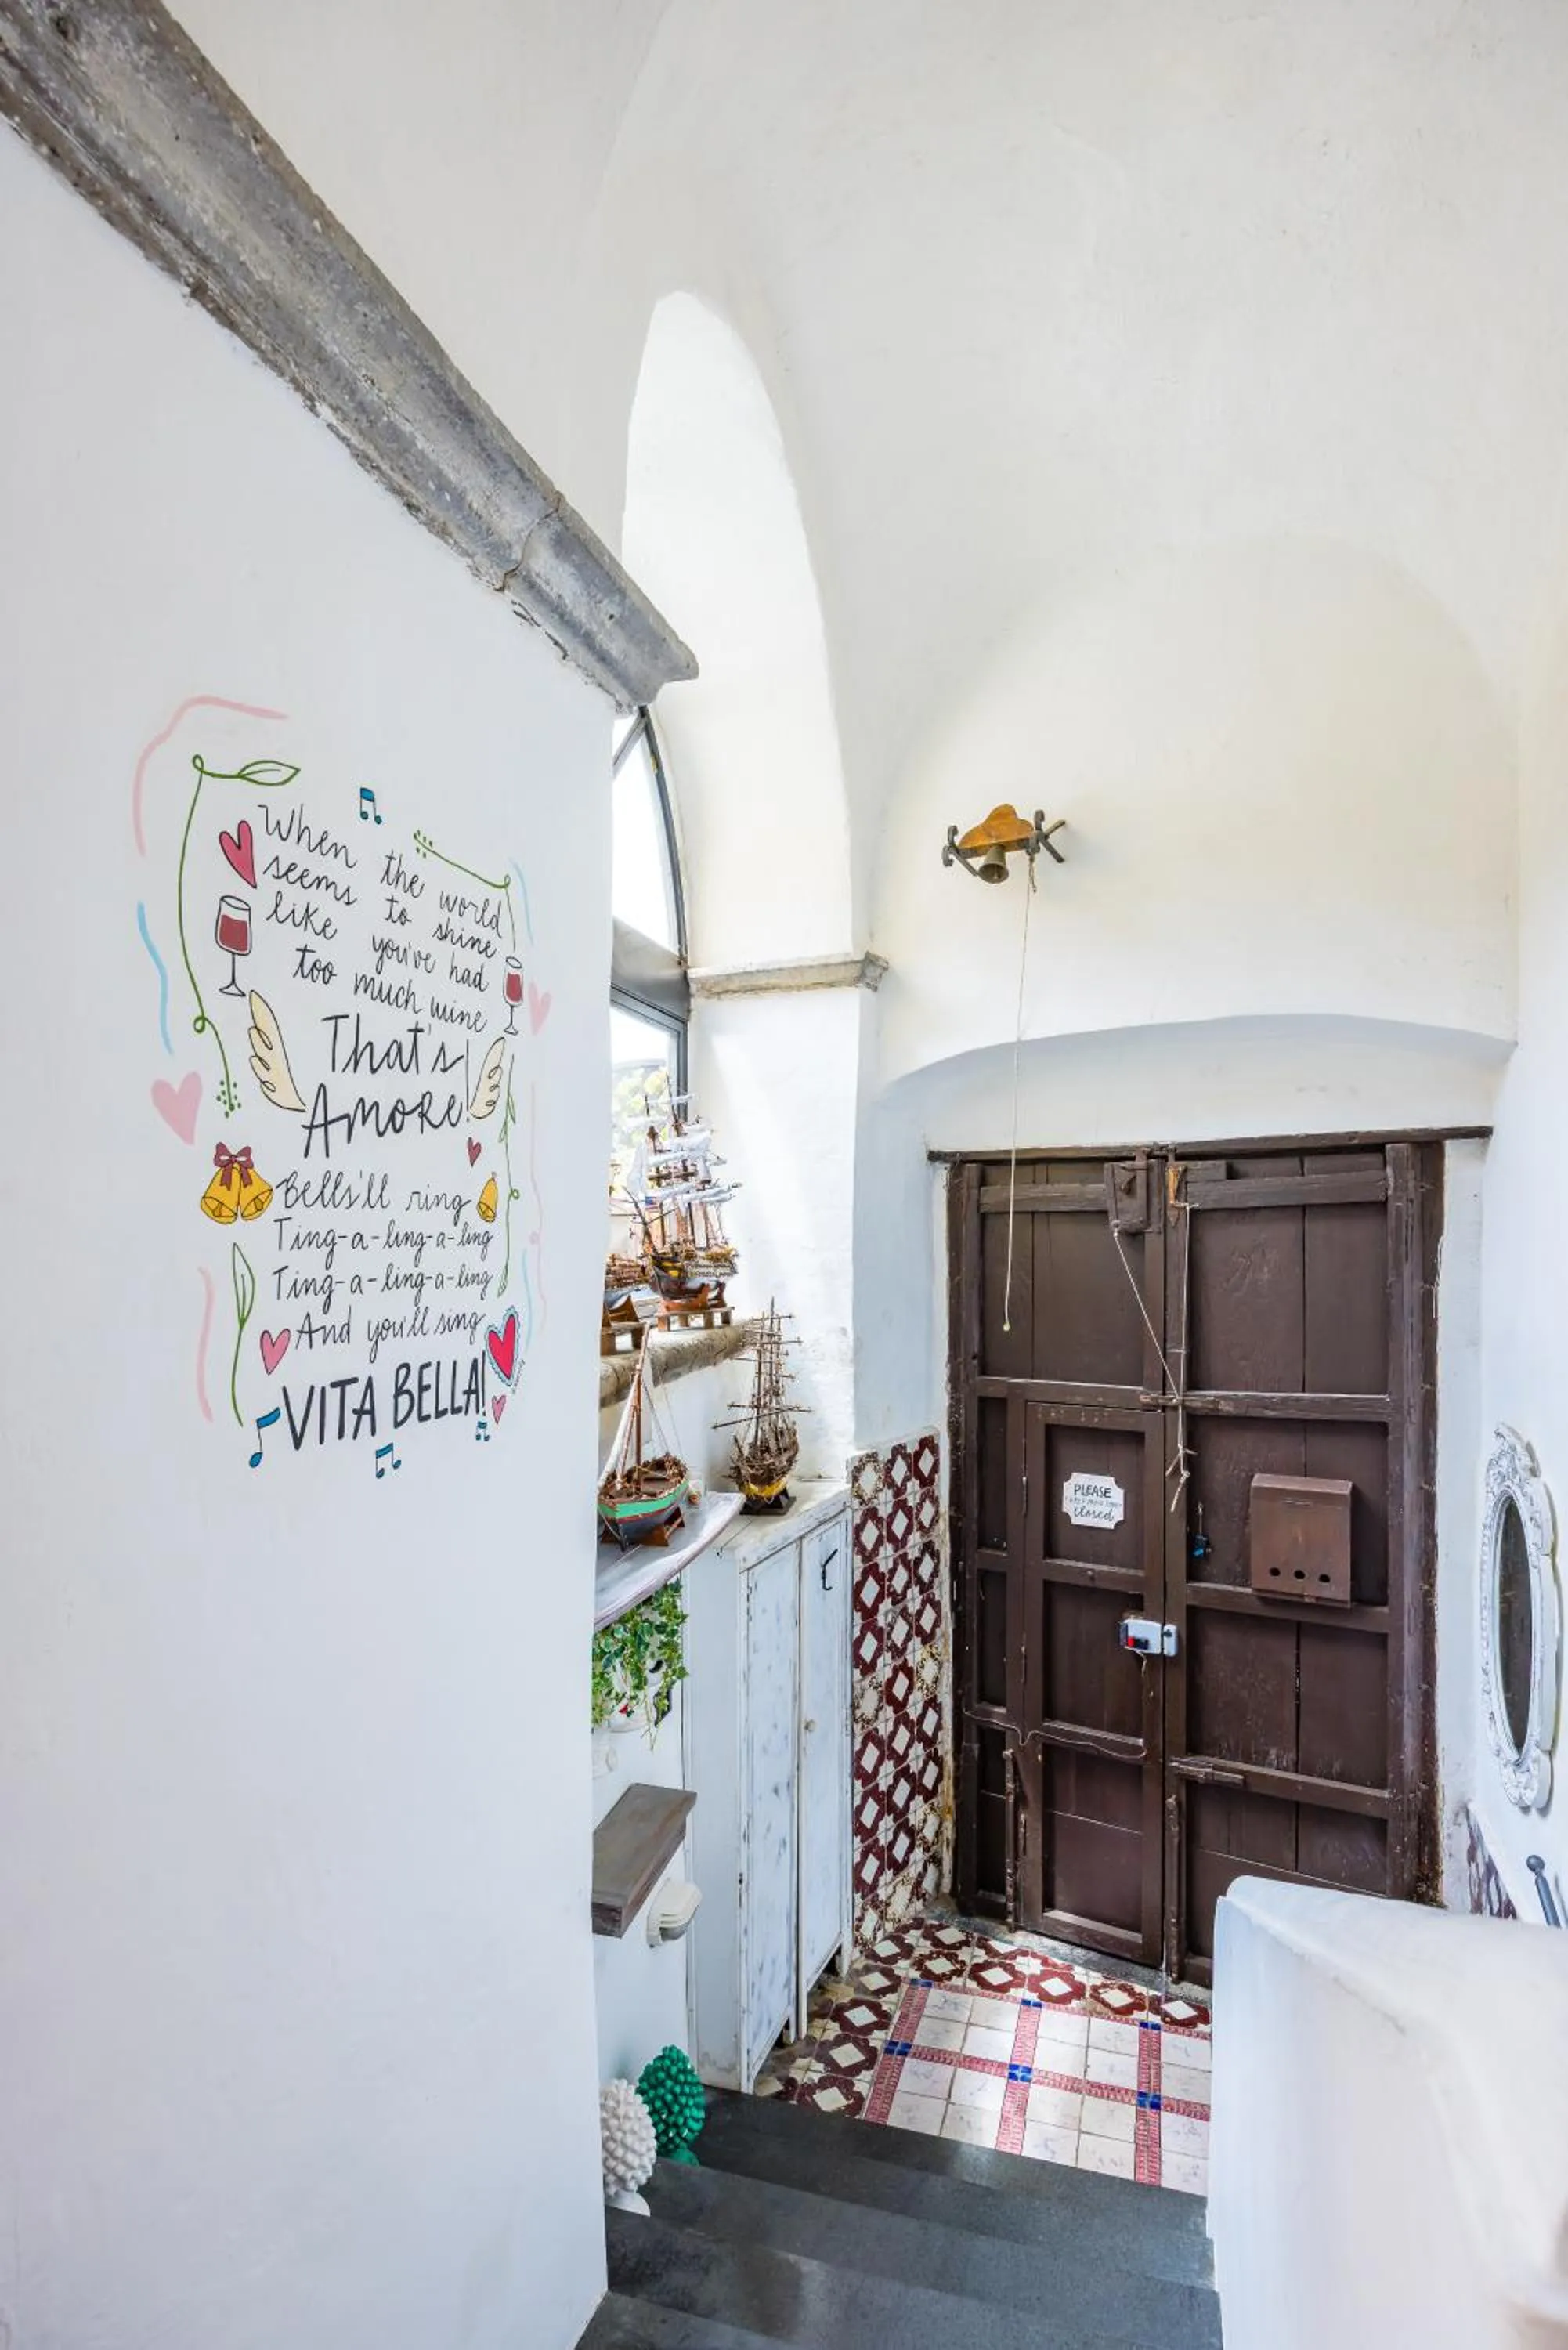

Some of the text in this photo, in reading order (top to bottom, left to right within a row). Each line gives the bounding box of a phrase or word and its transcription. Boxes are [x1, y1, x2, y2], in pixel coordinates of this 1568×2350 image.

[258, 804, 502, 938] When the world
[262, 855, 497, 958] seems to shine
[266, 890, 490, 992] like you've had
[293, 945, 488, 1033] too much wine
[321, 1013, 464, 1073] That's
[276, 1170, 472, 1226] Bells'll ring
[273, 1217, 494, 1270] Ting-a-ling-a-ling
[273, 1263, 494, 1314] Ting-a-ling-a-ling
[295, 1304, 487, 1363] And you'll sing
[283, 1350, 486, 1451] VITA BELLA!
[1074, 1484, 1111, 1498] PLEASE
